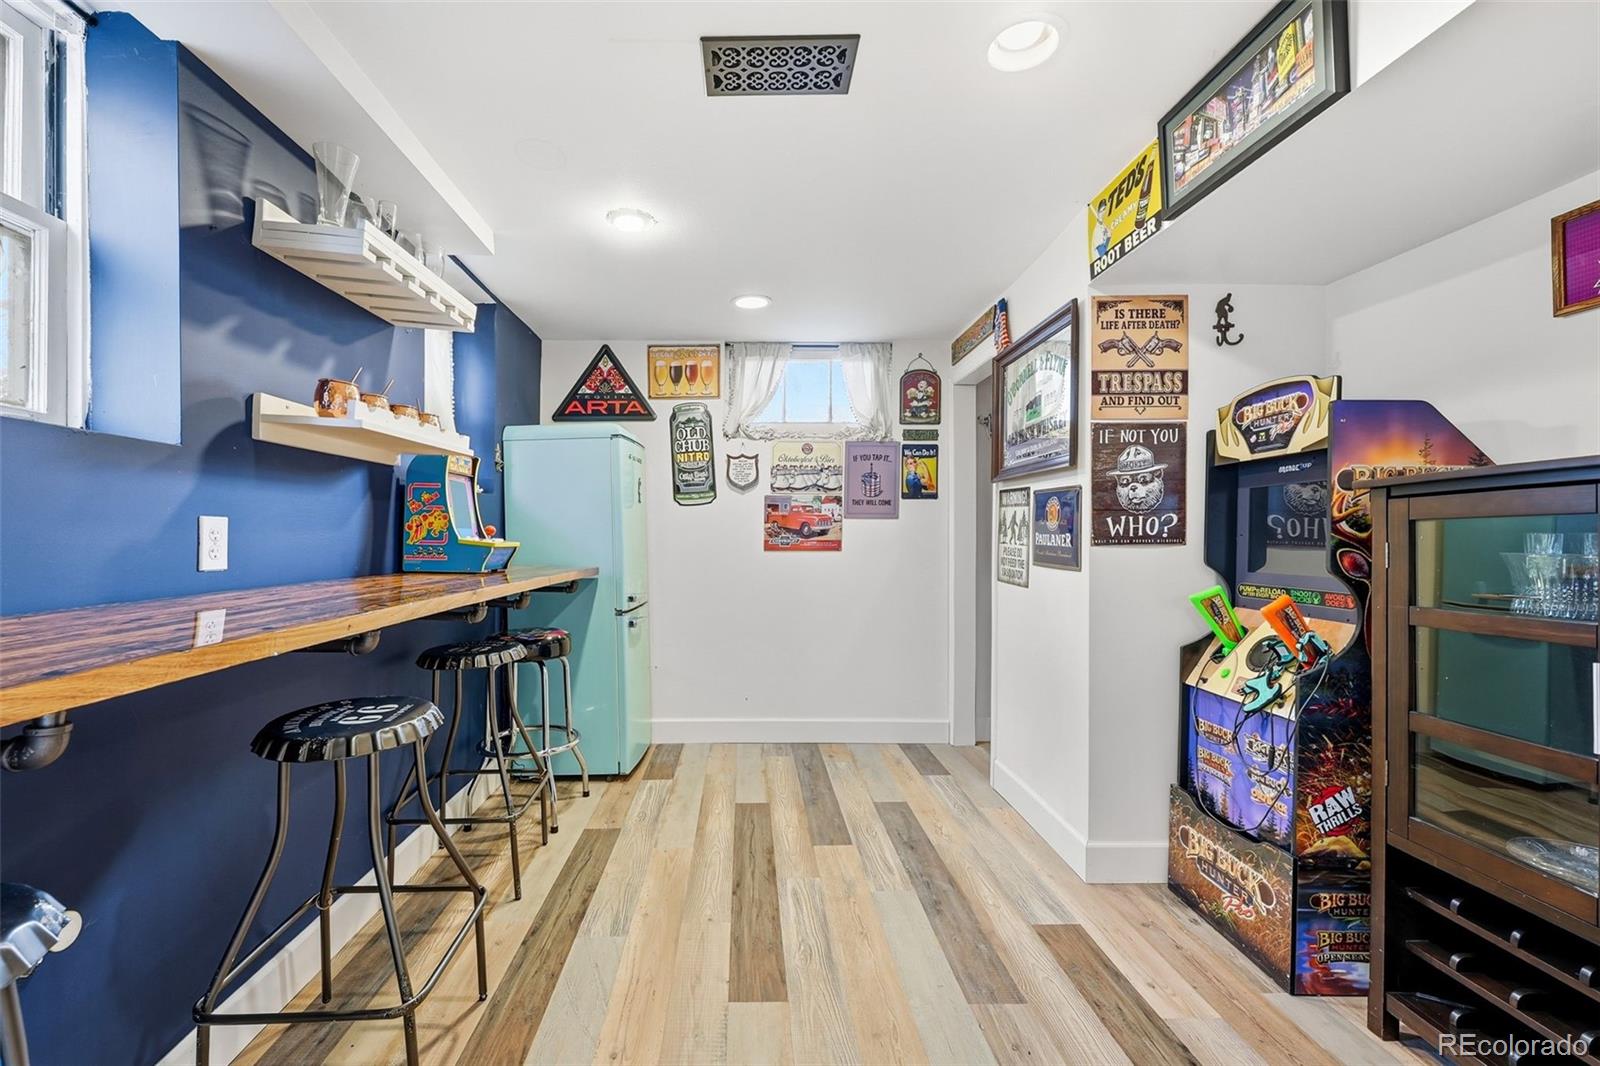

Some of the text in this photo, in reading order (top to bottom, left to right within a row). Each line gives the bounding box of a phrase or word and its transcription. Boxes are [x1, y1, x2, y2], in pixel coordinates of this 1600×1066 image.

[1107, 154, 1147, 216] TED'S
[1093, 217, 1157, 275] ROOT BEER
[1114, 308, 1167, 319] IS THERE
[1100, 320, 1181, 330] LIFE AFTER DEATH?
[1098, 371, 1183, 394] TRESPASS
[564, 400, 645, 415] ARTA
[1100, 396, 1180, 406] AND FIND OUT
[1243, 393, 1302, 423] BIG BUCK
[1253, 412, 1293, 428] HUNTER
[676, 427, 707, 440] OLD
[1099, 428, 1179, 444] IF NOT YOU
[674, 439, 710, 453] CHUB
[676, 452, 710, 463] NITRO
[852, 454, 858, 462] IF
[860, 454, 871, 462] YOU
[872, 453, 883, 462] TAP
[1106, 513, 1178, 537] WHO?
[1035, 532, 1073, 548] PAULANER
[1260, 587, 1286, 595] RELOAD
[1325, 593, 1345, 601] AVOID
[1326, 599, 1345, 607] DOES
[1309, 786, 1356, 825] RAW
[1316, 803, 1362, 834] THRILLS
[1187, 828, 1264, 902] BIG BUCK
[1200, 860, 1253, 906] HUNTER
[1318, 892, 1371, 912] BIG BUC
[1333, 908, 1369, 916] HUNTE
[1318, 932, 1370, 948] BIG BUC
[1331, 943, 1369, 951] HUNTE
[1317, 953, 1370, 963] OPEN SEAS
